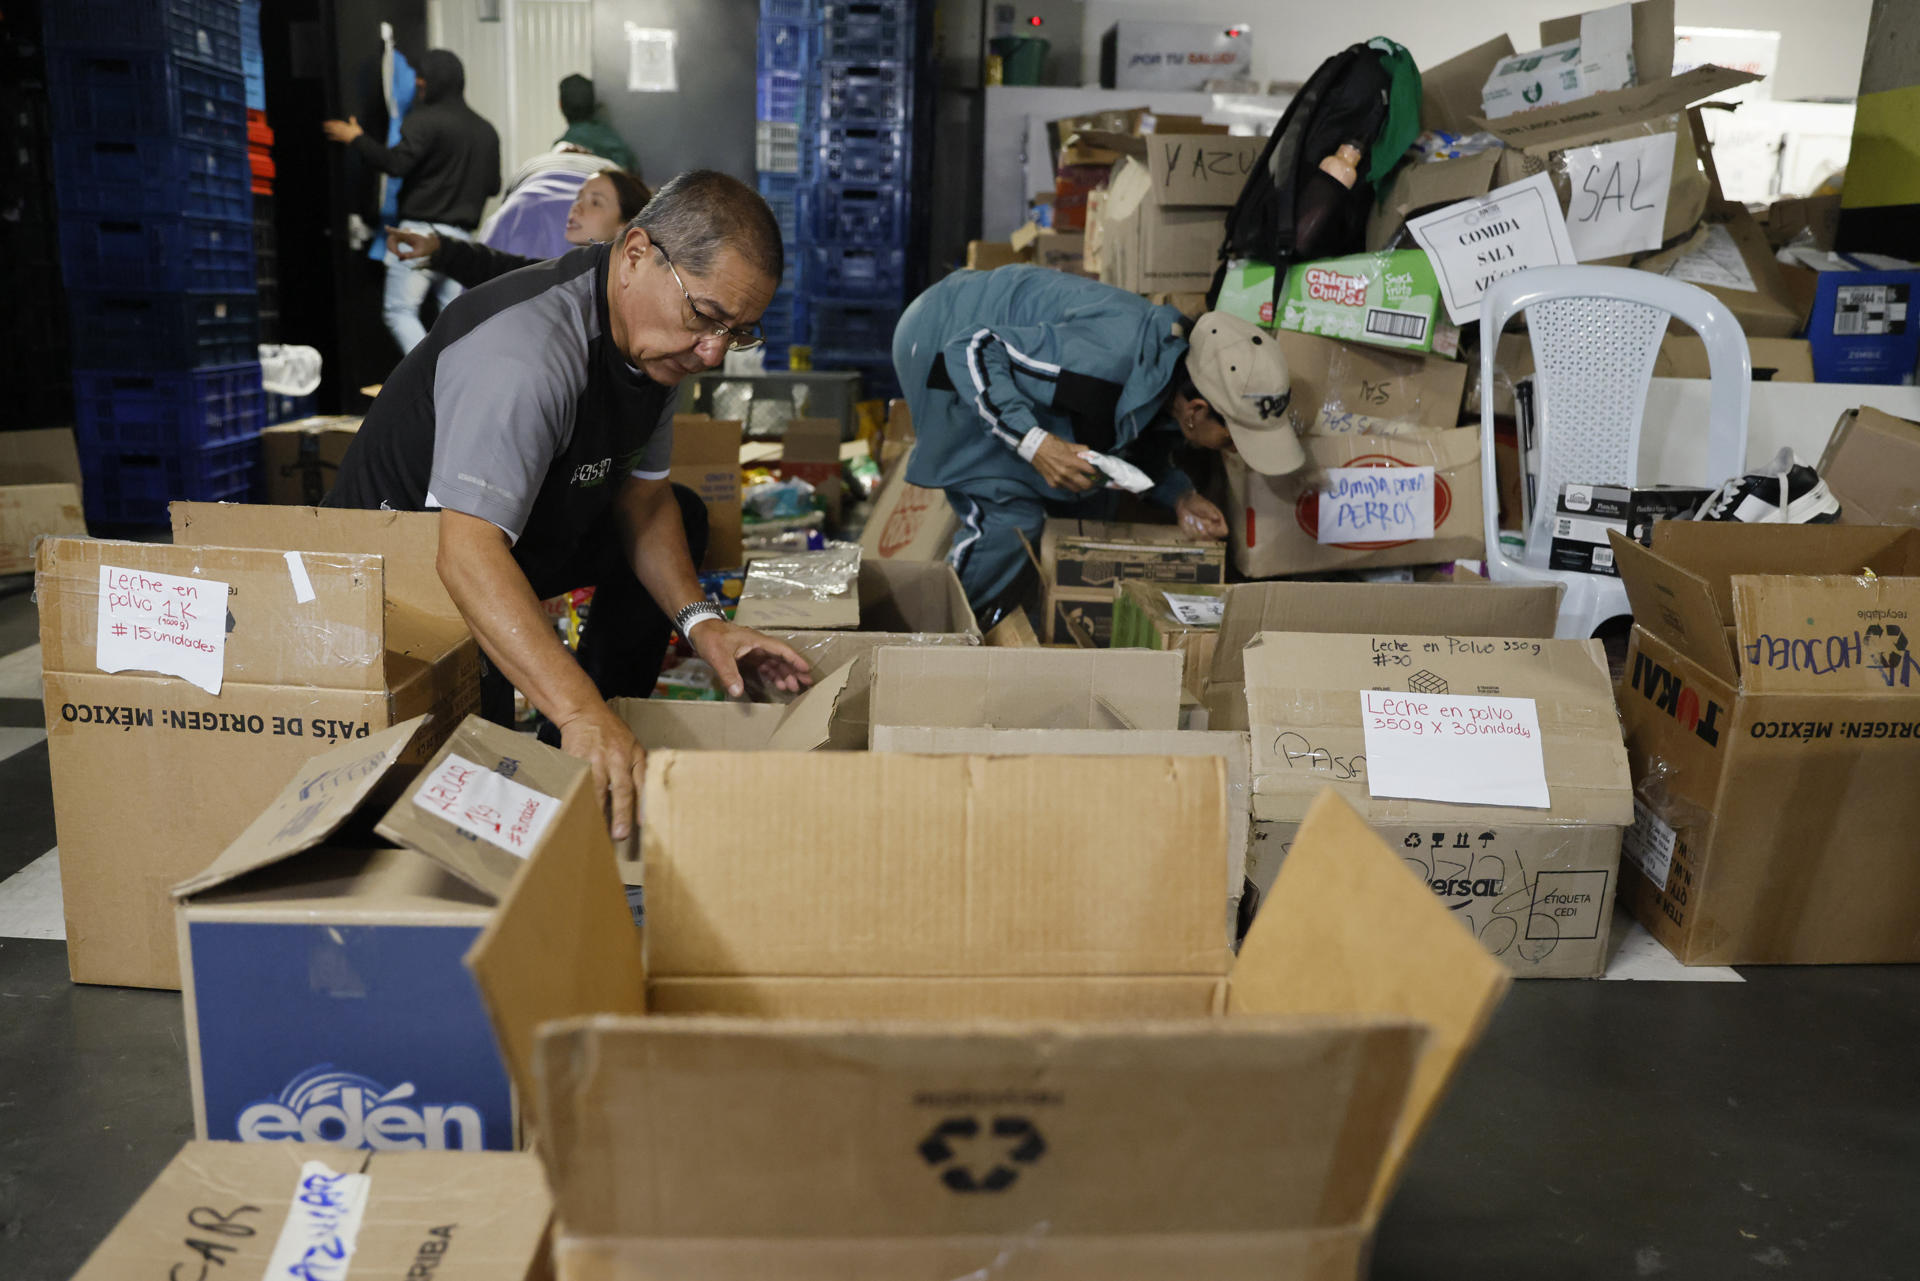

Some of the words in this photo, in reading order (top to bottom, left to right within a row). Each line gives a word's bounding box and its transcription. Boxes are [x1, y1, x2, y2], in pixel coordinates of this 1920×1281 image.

[1165, 143, 1182, 187] Y
[1578, 159, 1656, 223] SAL
[1458, 218, 1521, 247] COMIDA
[1477, 248, 1506, 267] SAL
[1506, 244, 1516, 259] Y
[1337, 496, 1416, 535] PERROS
[109, 569, 163, 593] Leche
[172, 585, 198, 600] en
[109, 591, 152, 612] polvo
[1857, 609, 1908, 621] recyclable
[1372, 638, 1410, 653] Leche
[1423, 643, 1440, 653] en
[61, 702, 154, 732] MÉXICO
[162, 708, 265, 735] ORIGEN:
[1367, 693, 1430, 716] Leche
[1440, 704, 1463, 718] en
[1469, 705, 1513, 724] polvo
[272, 716, 304, 736] DE
[310, 718, 370, 745] PAÍS
[1373, 718, 1423, 735] 350g
[1750, 721, 1833, 744] MÉXICO
[1428, 878, 1501, 897] ersal
[1544, 894, 1591, 904] ETIQUETA
[1554, 908, 1577, 917] CEDI
[1662, 900, 1684, 927] ITEM
[237, 1081, 484, 1152] edén
